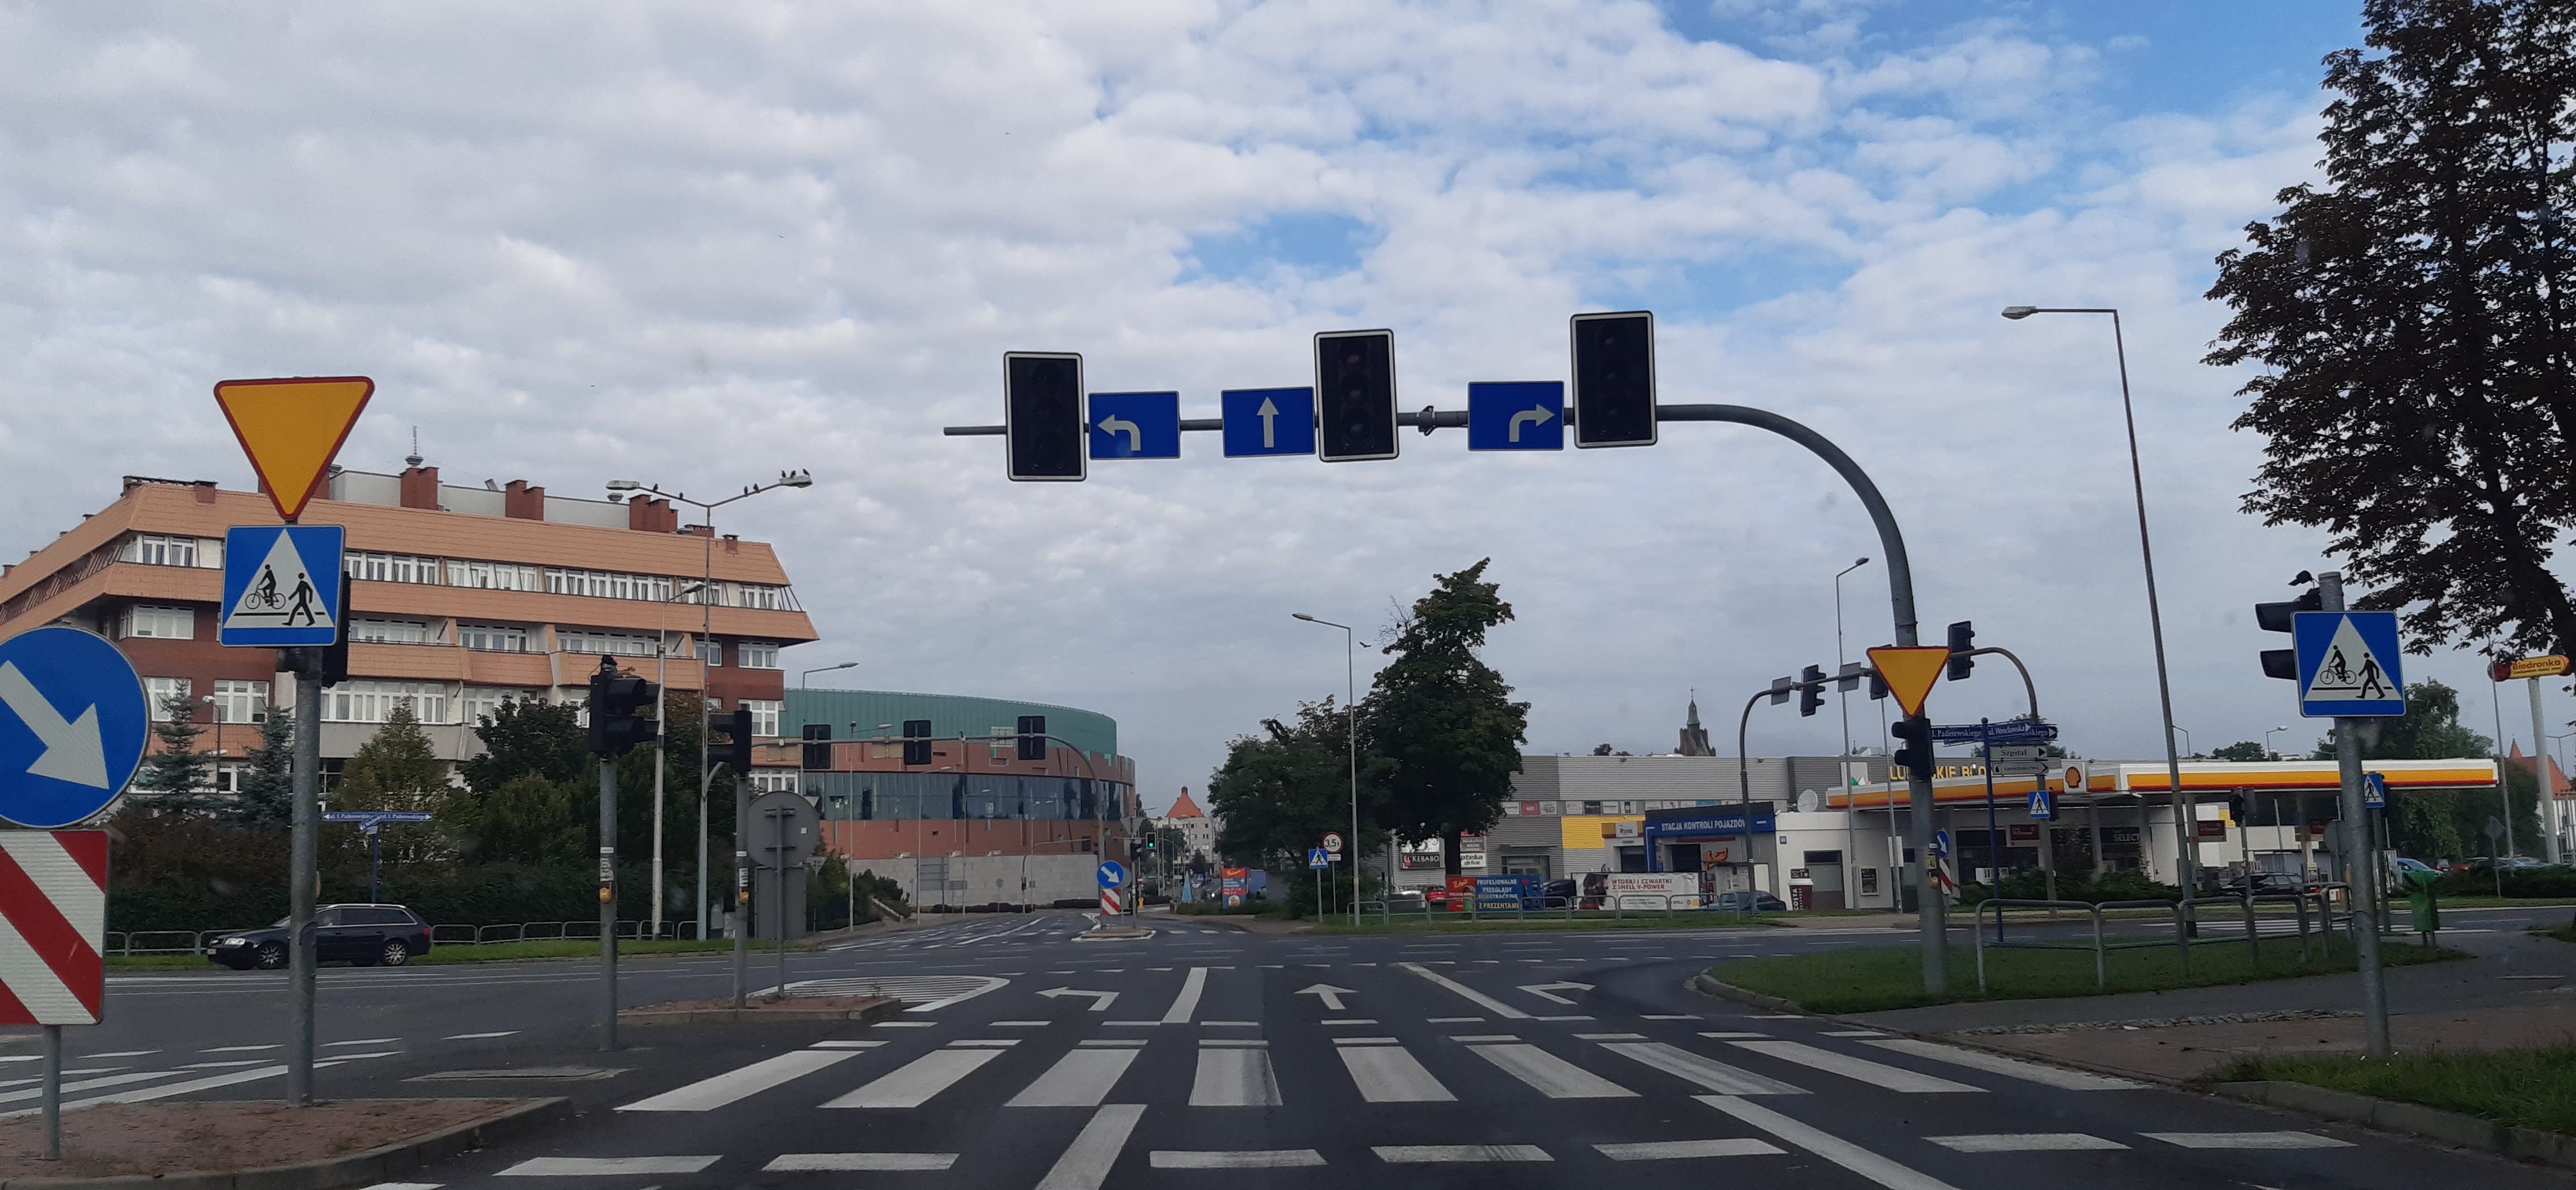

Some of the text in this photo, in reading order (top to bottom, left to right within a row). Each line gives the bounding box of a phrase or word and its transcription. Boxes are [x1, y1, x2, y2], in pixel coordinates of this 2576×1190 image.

[2512, 659, 2561, 670] Biedronka
[1938, 729, 1981, 738] Paderewskiego
[1661, 822, 1682, 832] STACJA
[1683, 820, 1713, 830] KONTROLI
[2114, 833, 2140, 842] SELECT
